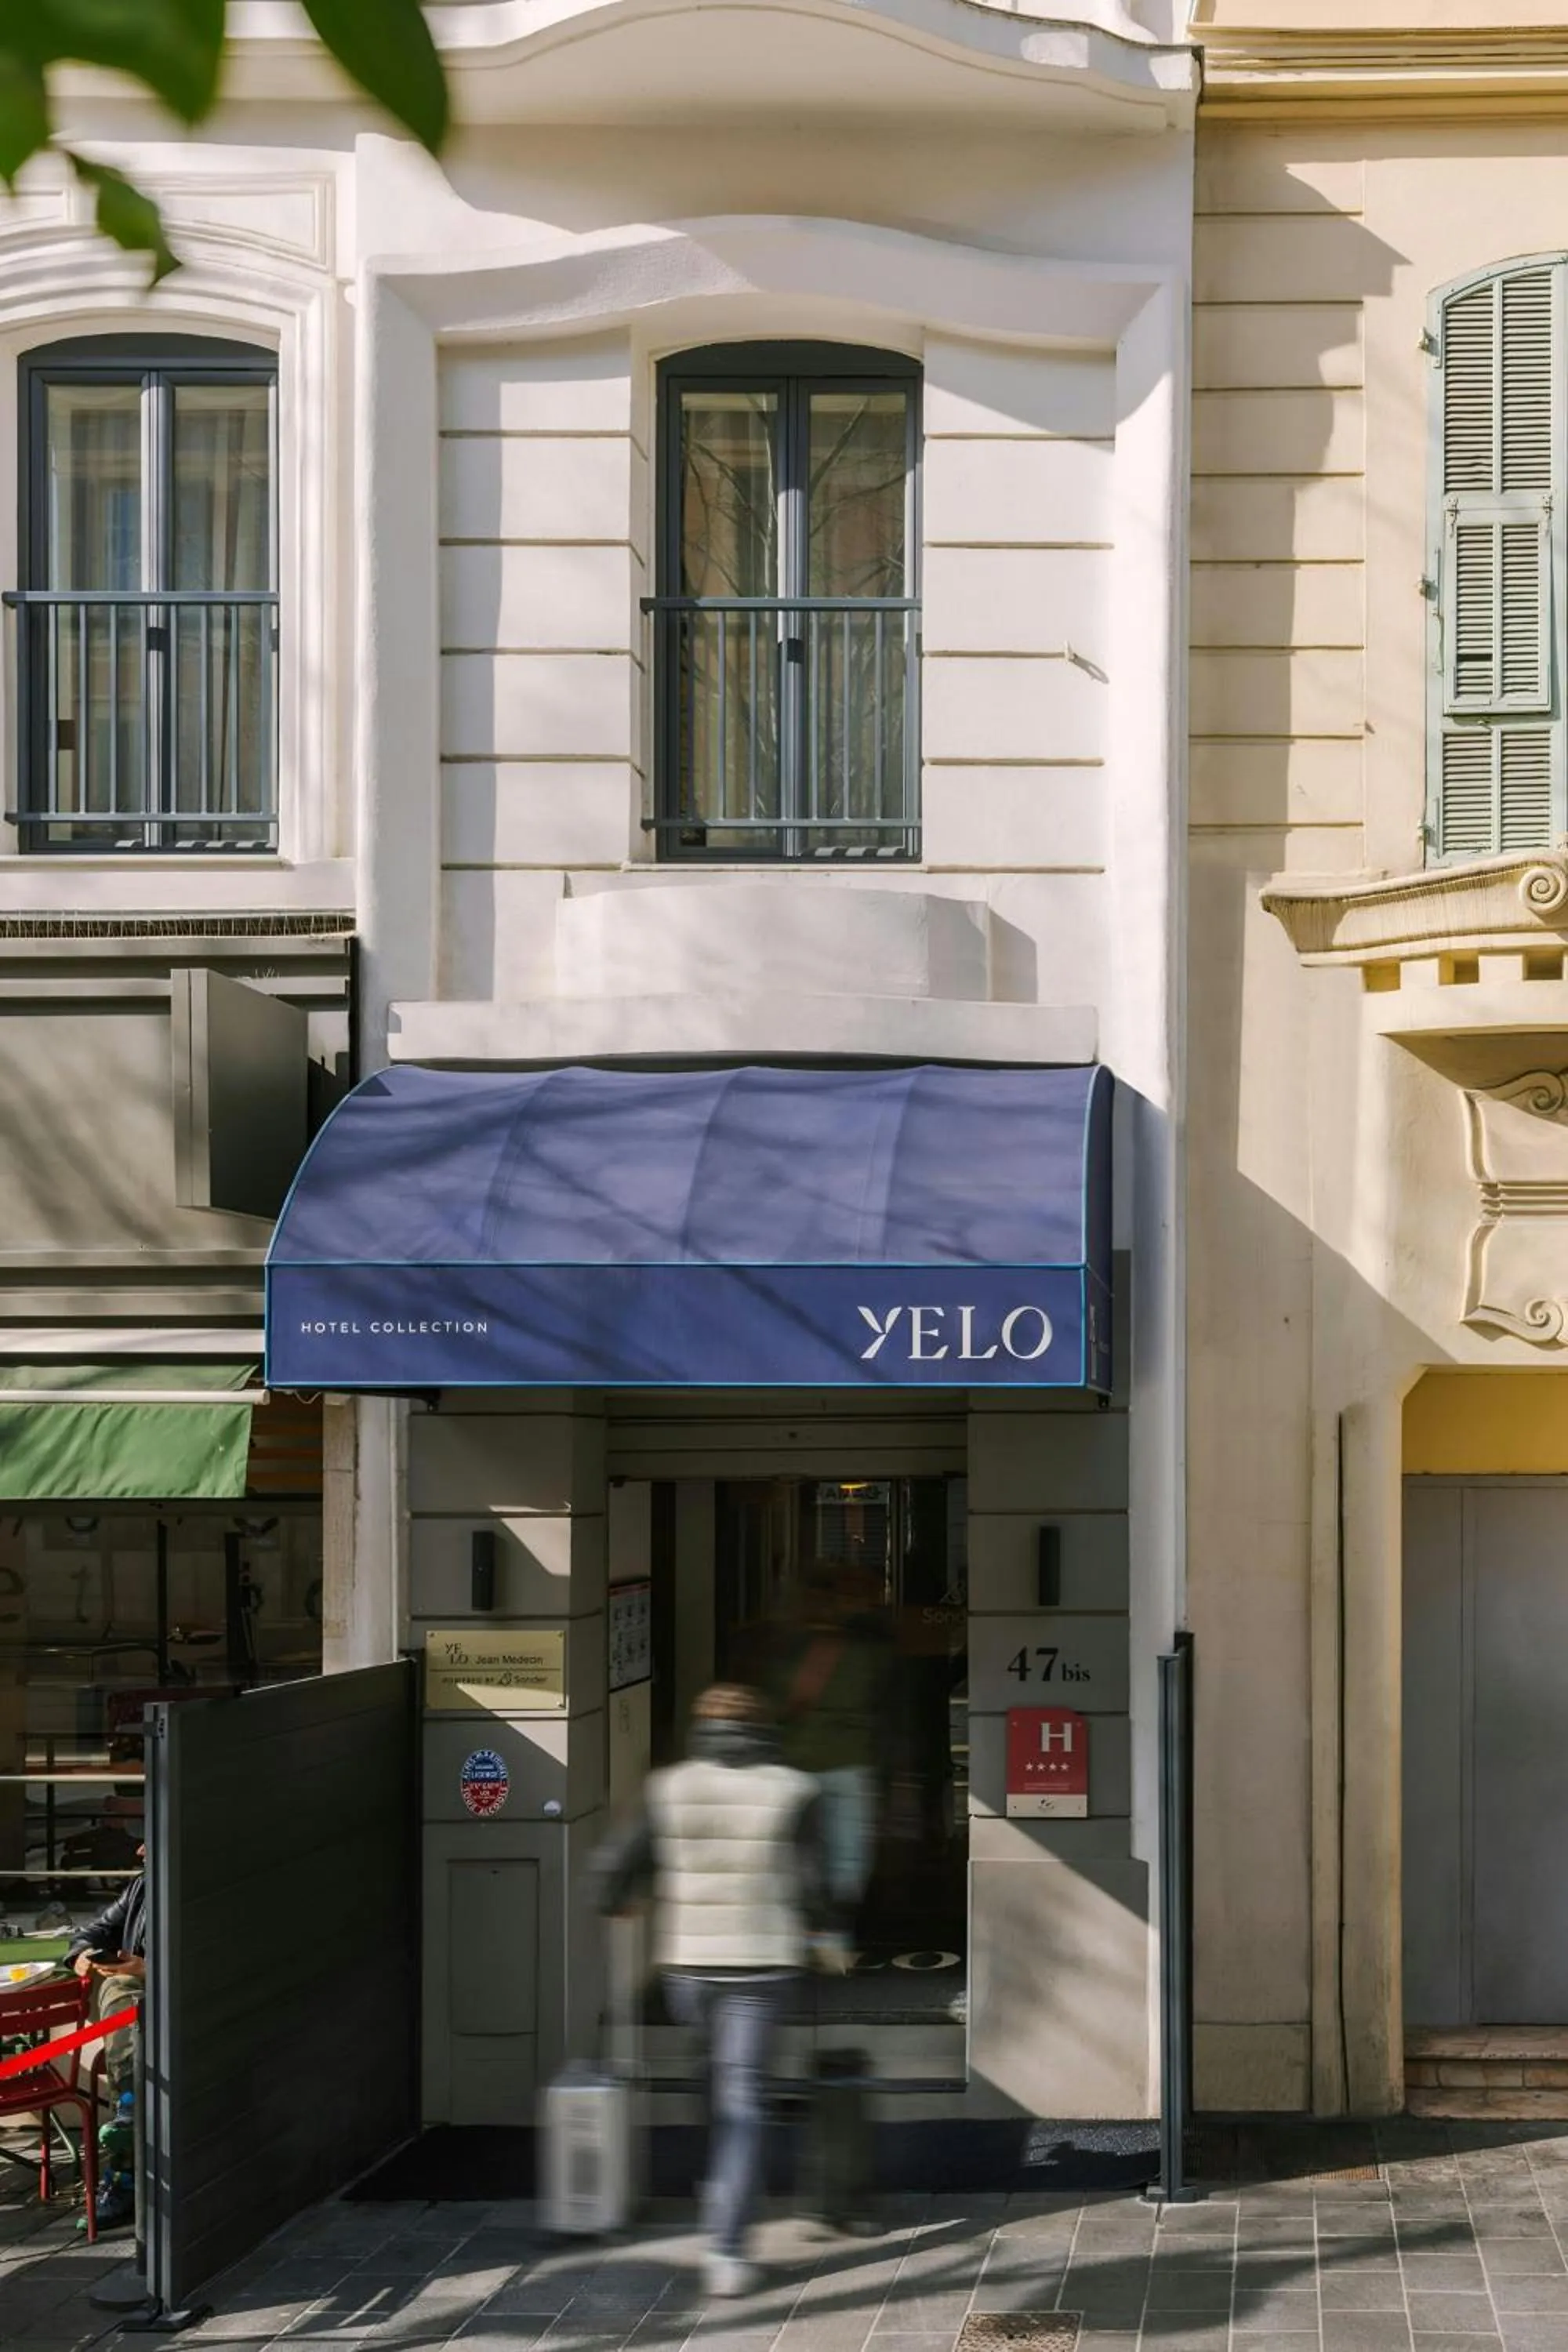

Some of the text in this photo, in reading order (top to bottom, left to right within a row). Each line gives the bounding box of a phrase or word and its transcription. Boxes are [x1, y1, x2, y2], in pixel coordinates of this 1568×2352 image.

[300, 1321, 489, 1334] HOTEL COLLECTION
[856, 1305, 1054, 1360] YELO
[475, 1655, 499, 1665] Jean
[1040, 1722, 1073, 1752] H
